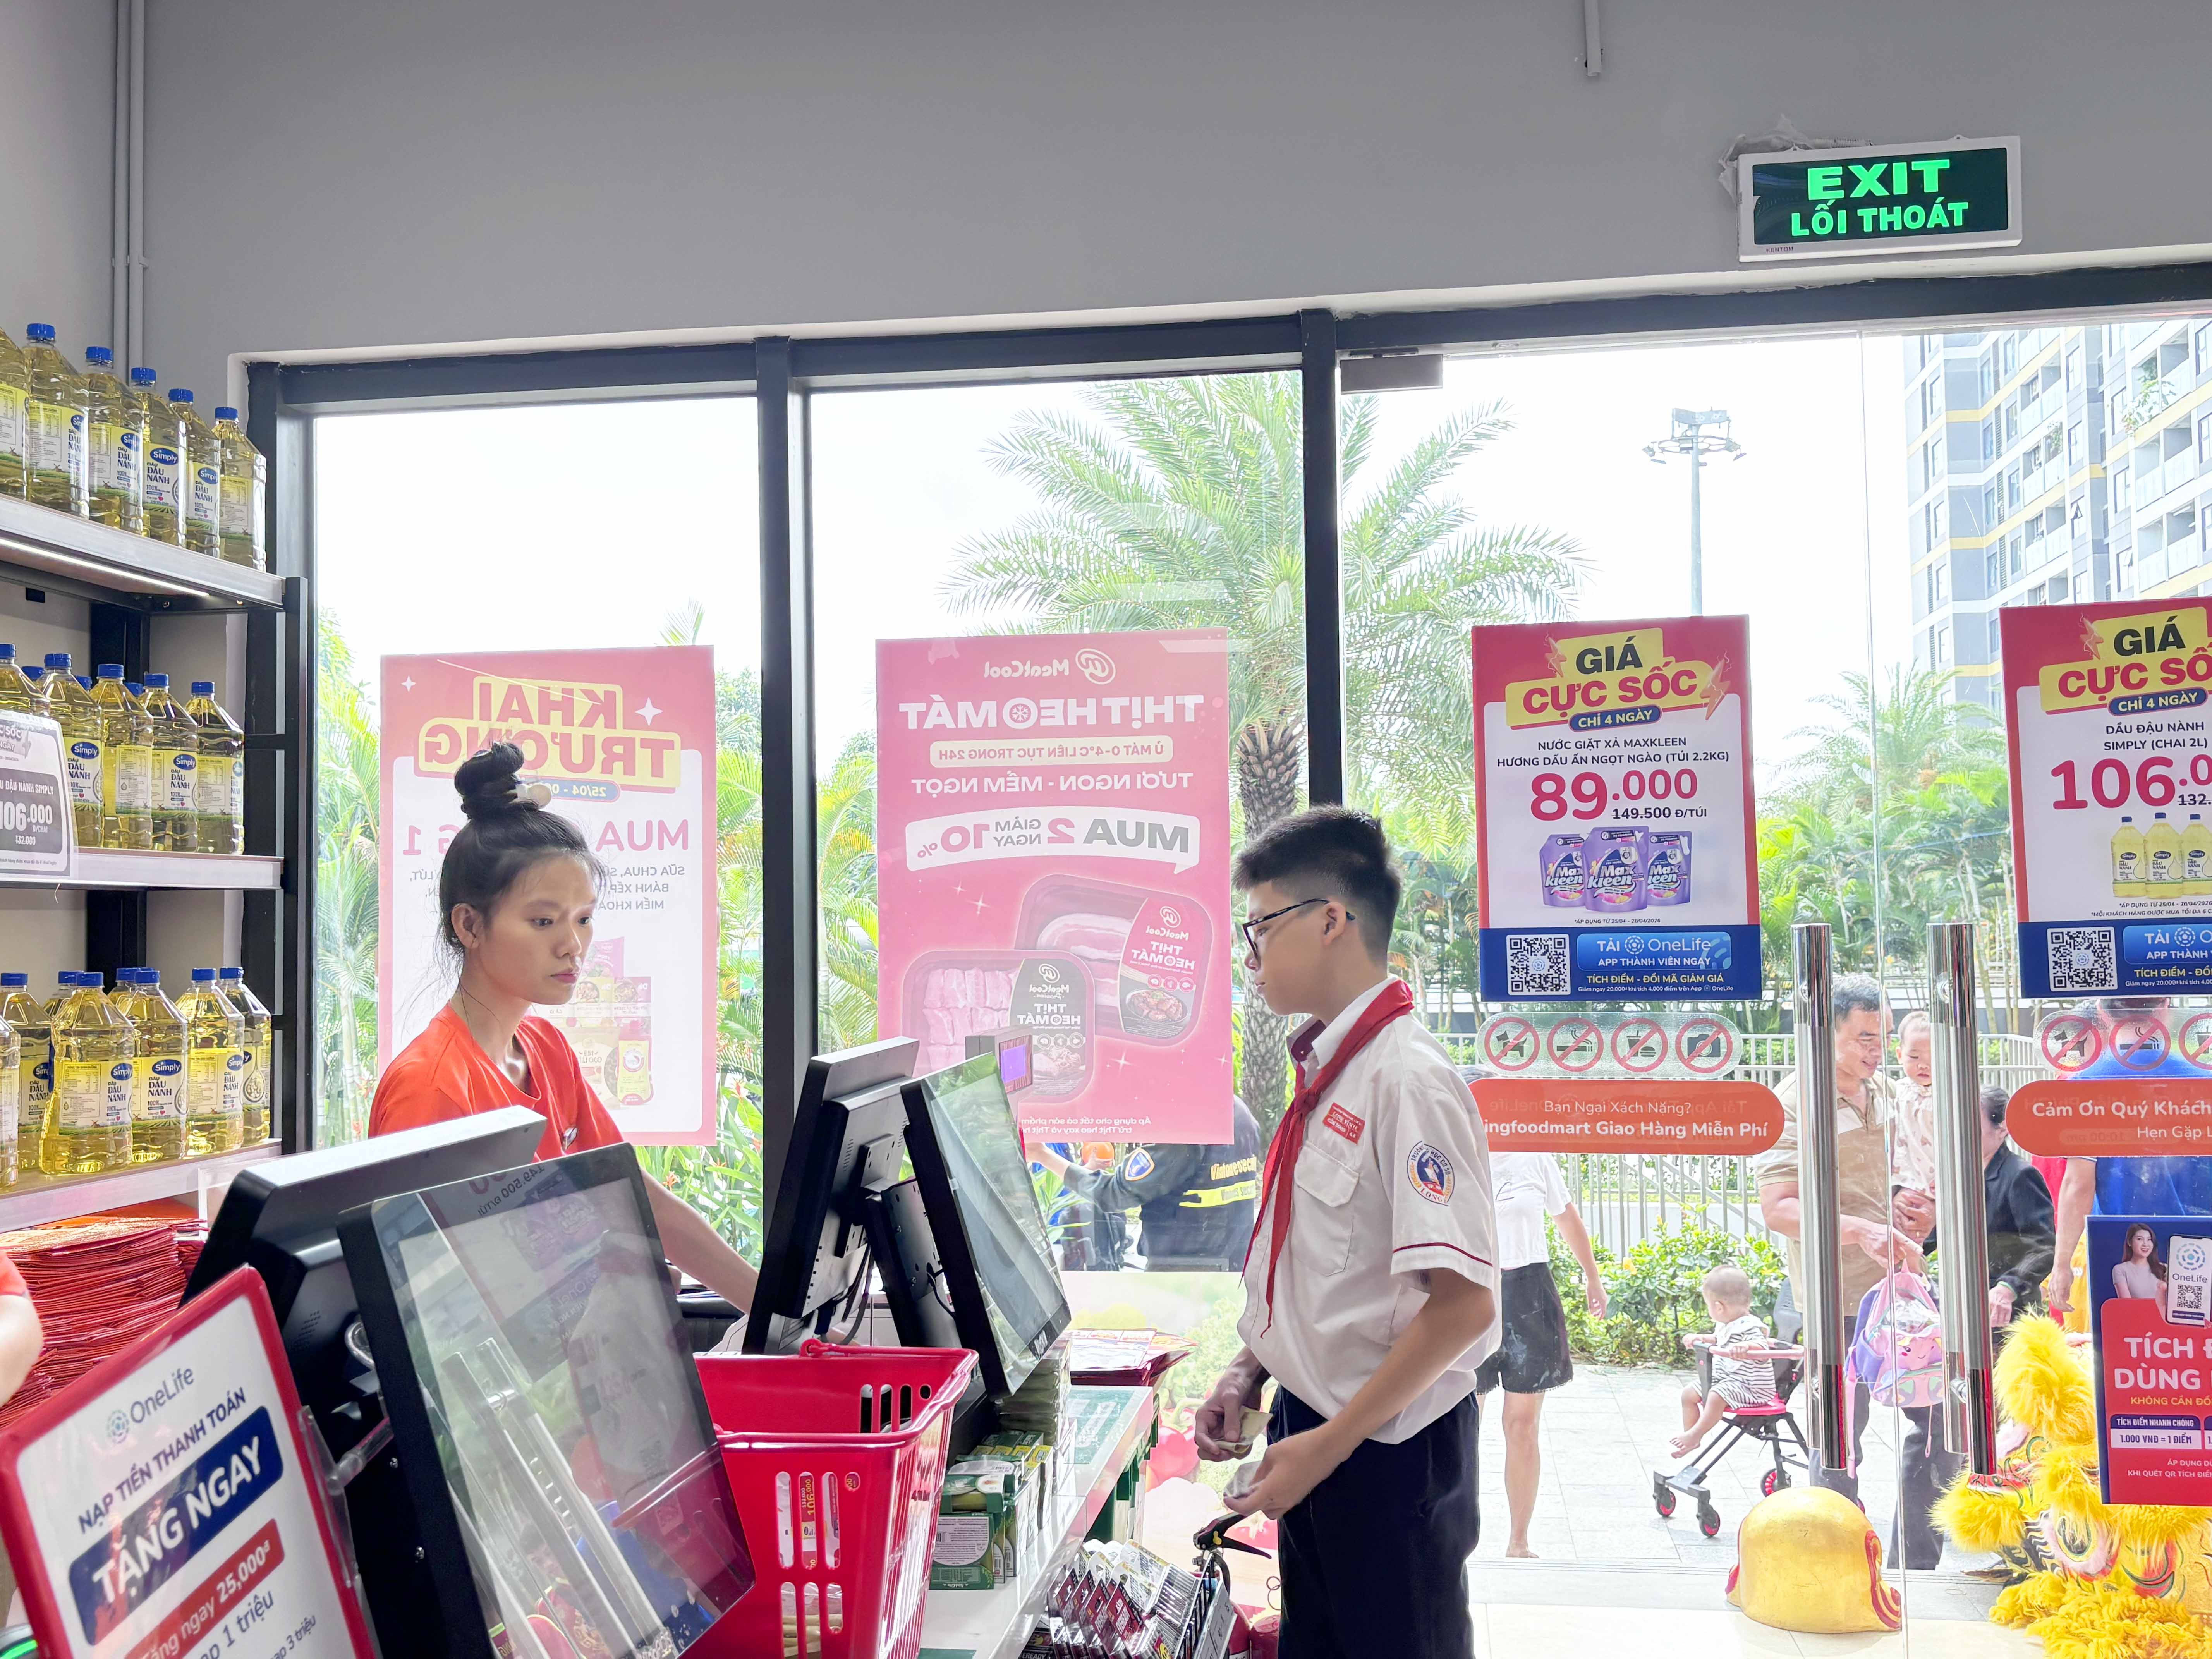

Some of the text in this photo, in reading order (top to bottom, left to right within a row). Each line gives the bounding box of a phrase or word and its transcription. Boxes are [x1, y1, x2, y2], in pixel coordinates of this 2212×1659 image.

[1808, 159, 1950, 200] EXIT
[1791, 197, 1968, 236] LỐI THOÁT
[154, 449, 177, 463] Simply
[201, 469, 218, 481] Simply
[2114, 615, 2186, 656] GIÁ
[1576, 635, 1642, 675] GIÁ
[1523, 660, 1697, 717] CỰC SỐC
[2058, 663, 2148, 702] CỰC
[2118, 692, 2198, 712] CHỈ 4 NGÀY
[1578, 709, 1652, 728] CHỈ 4 NGÀY
[2106, 720, 2204, 736] DẦU ĐẬU NÀNH
[73, 744, 97, 755] Simply
[1538, 737, 1686, 751] NƯỚC GIẶT XẢ MAXKLEEN
[2104, 738, 2208, 751] SIMPLY (CHAI 2L)
[175, 757, 195, 767] Simply
[1497, 750, 1729, 767] HƯƠNG DẤU ẤN NGỌT NGÀO (TÚI 2.2KG)
[6, 779, 53, 795] ĐẬU NÀNH SIMPLY
[1531, 769, 1697, 821] 89.000
[1612, 807, 1707, 820] 149.500 Đ/TÚI
[1600, 865, 1636, 877] Max
[1597, 938, 1711, 951] TẢI OneLife
[2144, 929, 2169, 944] TẢI
[1620, 956, 1655, 966] THÀNH
[1659, 956, 1681, 966] VIÊN
[1683, 957, 1711, 965] NGAY
[2147, 948, 2208, 960] APP THÀNH
[1587, 972, 1724, 983] TÍCH ĐIỂM ĐỔI MÃ GIẢM GIÁ
[113, 1067, 132, 1076] Simply
[155, 1061, 180, 1072] Simply
[1545, 1101, 1571, 1116] Bạn
[1575, 1101, 1606, 1116] Ngại
[1610, 1100, 1644, 1113] Xách
[1648, 1101, 1691, 1117] Nặng?
[2032, 1100, 2211, 1119] Cảm Ơn Quý Khách
[1484, 1118, 1767, 1139] ingfoodmart Giao Hàng Miễn Phí
[2138, 1125, 2202, 1140] Hẹn Gặp
[2172, 1273, 2208, 1283] OneLife
[2123, 1332, 2194, 1358] TÍCH
[2114, 1362, 2200, 1390] DÙNG
[131, 1368, 194, 1423] OneLife
[2131, 1396, 2168, 1405] KHÔNG
[2142, 1435, 2159, 1443] VNĐ
[2174, 1432, 2191, 1444] ĐIỂM
[78, 1493, 113, 1534] NẠP
[153, 1419, 206, 1471] THANH
[206, 1387, 246, 1428] TOÁN
[92, 1436, 260, 1604] TẶNG NGAY
[181, 1597, 214, 1639] ngay
[223, 1591, 274, 1647] 1 triệu
[287, 1615, 316, 1650] 3 triệu
